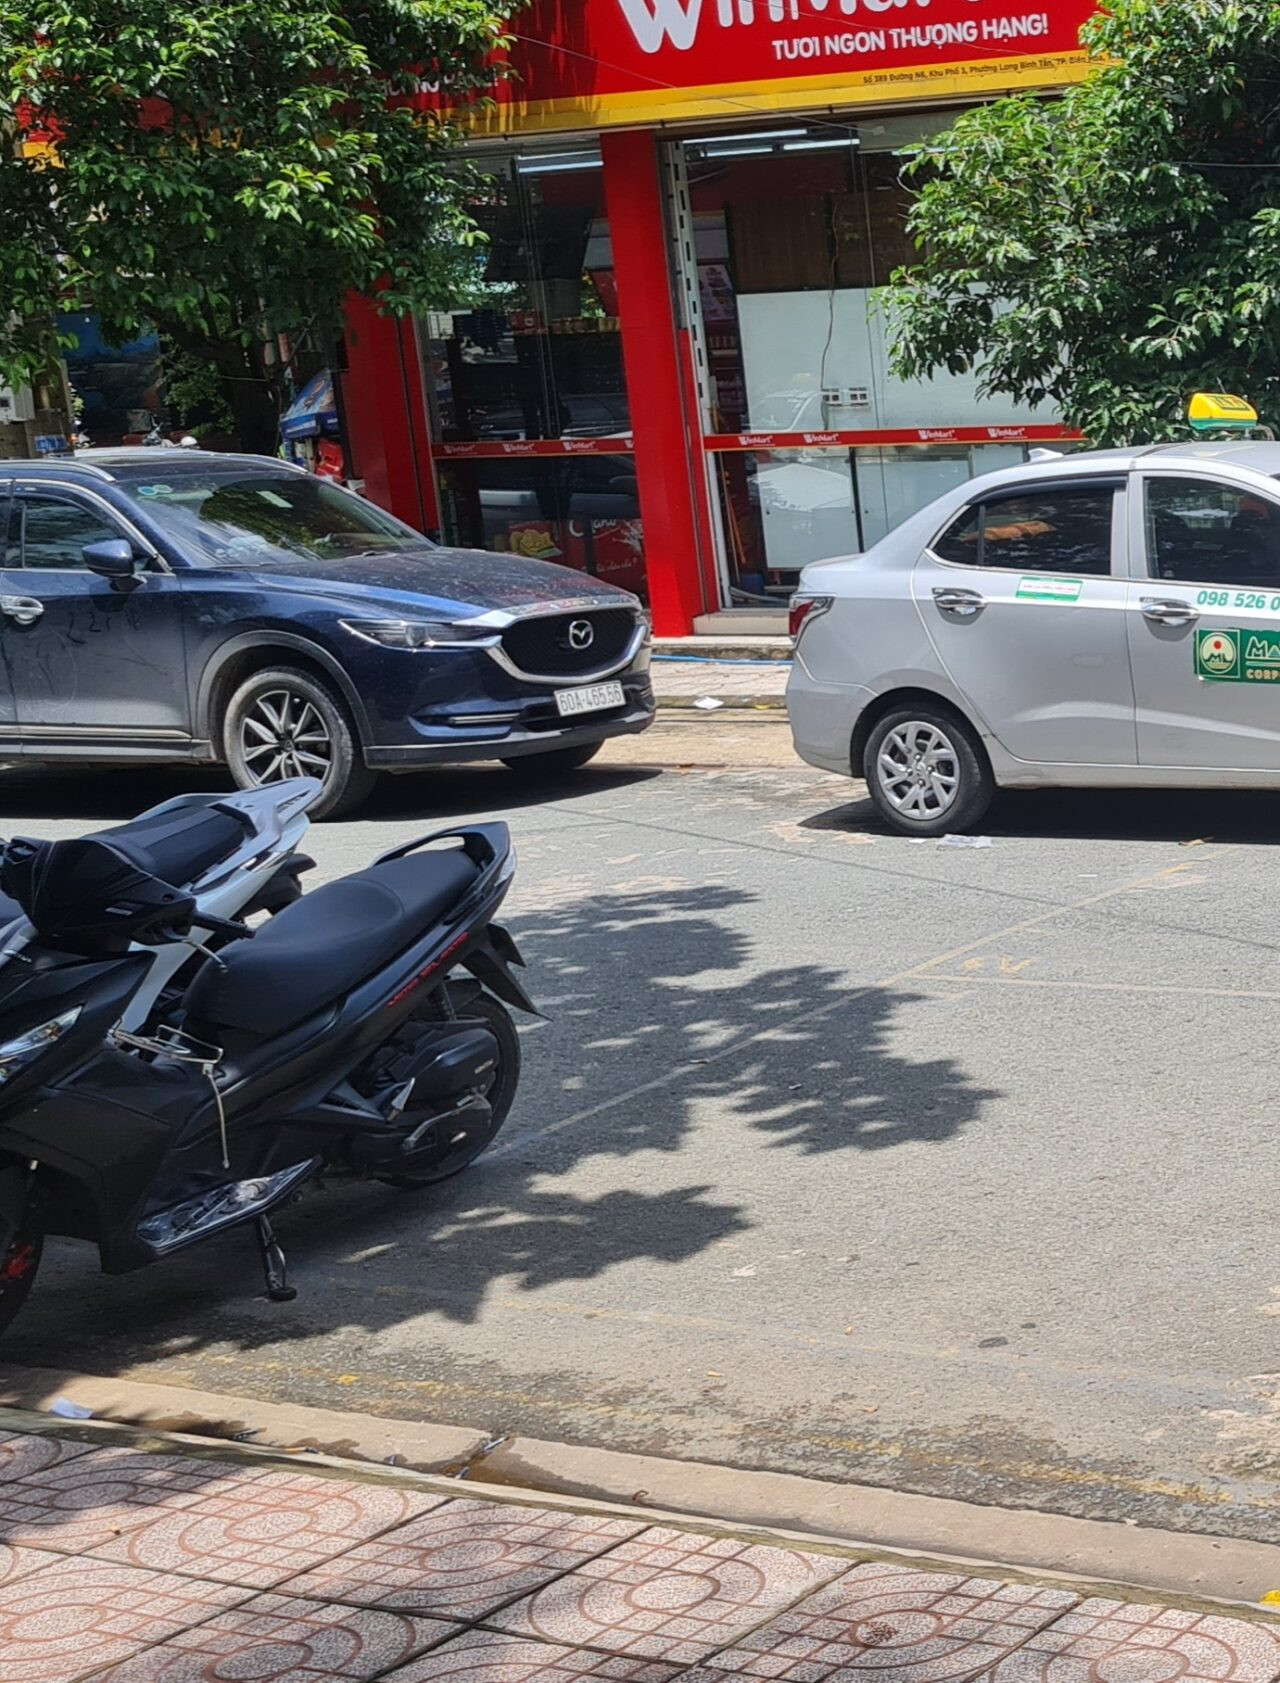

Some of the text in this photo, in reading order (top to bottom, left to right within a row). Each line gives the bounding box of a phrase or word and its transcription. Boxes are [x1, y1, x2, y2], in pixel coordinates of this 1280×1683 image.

[772, 37, 820, 60] TƯƠI
[825, 30, 886, 55] NGON
[888, 21, 978, 50] THƯỢNG
[982, 13, 1049, 43] HẠNG!
[929, 69, 944, 77] Khu
[999, 63, 1018, 73] Long
[1196, 590, 1229, 607] 098
[1234, 592, 1266, 610] 526
